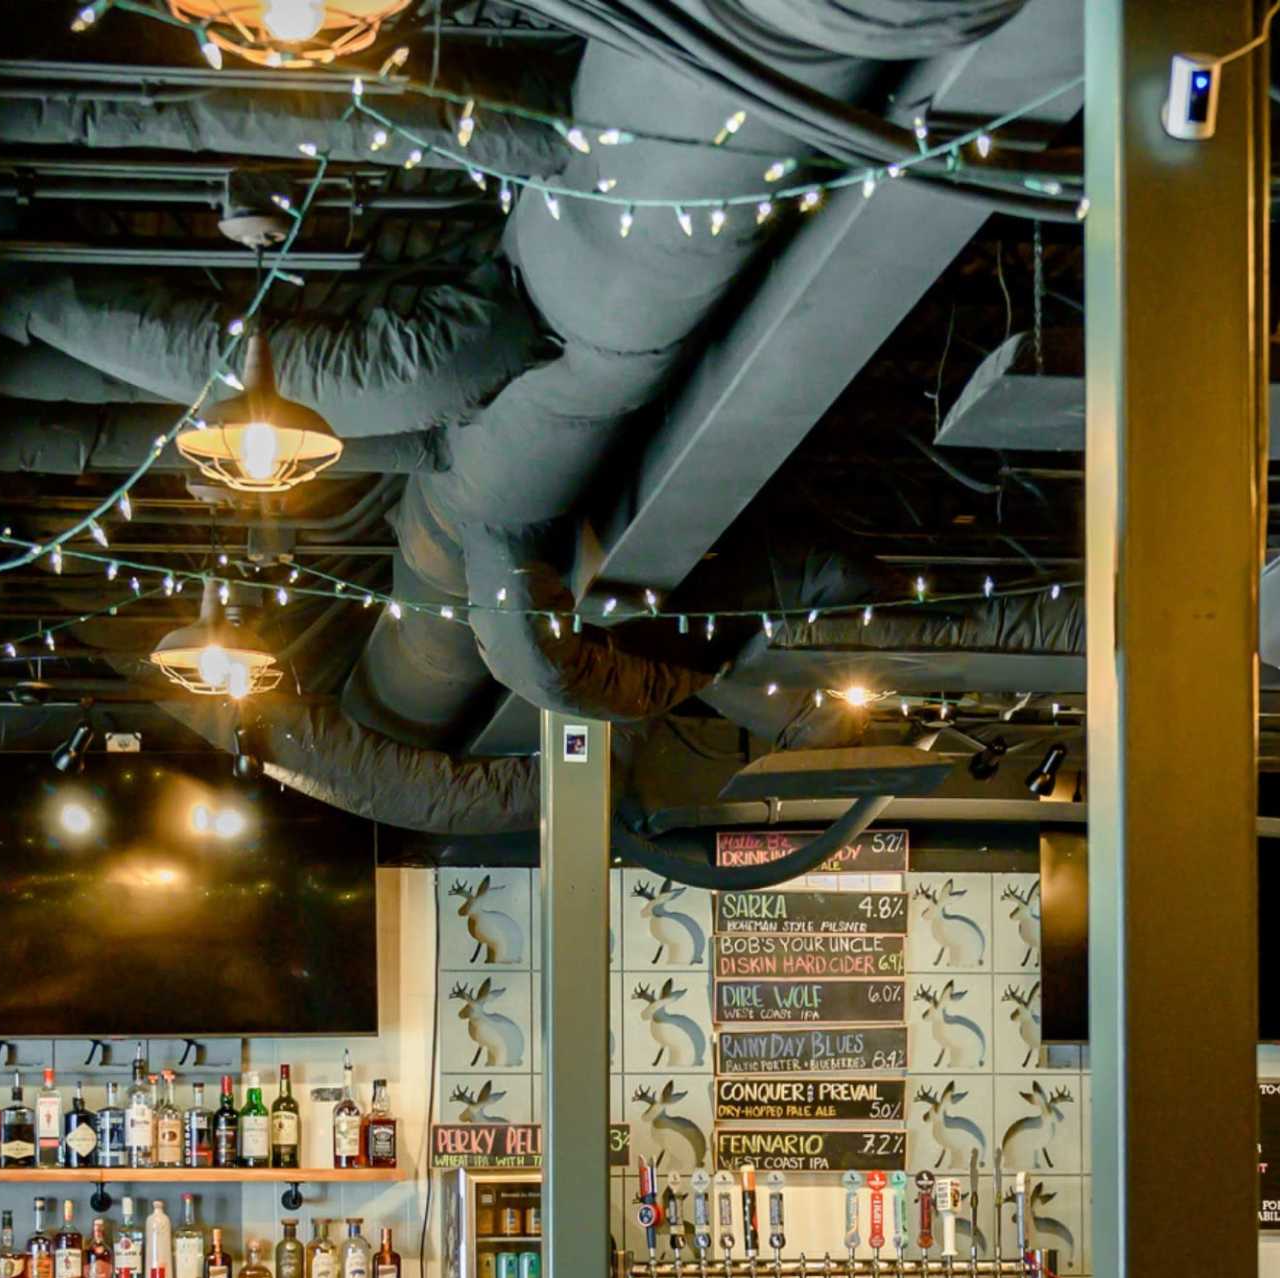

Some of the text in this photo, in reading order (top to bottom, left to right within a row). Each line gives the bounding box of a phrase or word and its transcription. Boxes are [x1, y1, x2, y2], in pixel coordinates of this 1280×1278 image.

[722, 894, 904, 918] SARKA 4.8%
[782, 920, 814, 931] STYLE
[720, 937, 884, 953] BOB'S YOUR UNCLE
[720, 956, 777, 974] DISKIN
[783, 956, 826, 973] HARD
[829, 956, 875, 972] CIDER
[722, 985, 901, 1008] DIRE WOLF 6.0%
[771, 1034, 806, 1057] DAY
[761, 1058, 801, 1071] PORTER
[720, 1082, 805, 1102] CONQUER
[820, 1083, 883, 1101] PREVAIL
[786, 1105, 812, 1116] PALE
[815, 1105, 837, 1117] ALE
[437, 1128, 496, 1154] PERKY
[506, 1126, 542, 1154] PELI
[720, 1134, 823, 1154] FENNARIO
[435, 1155, 468, 1167] WHEAT
[496, 1155, 524, 1167] WITH
[764, 1156, 805, 1169] COAST
[810, 1157, 829, 1169] IPA
